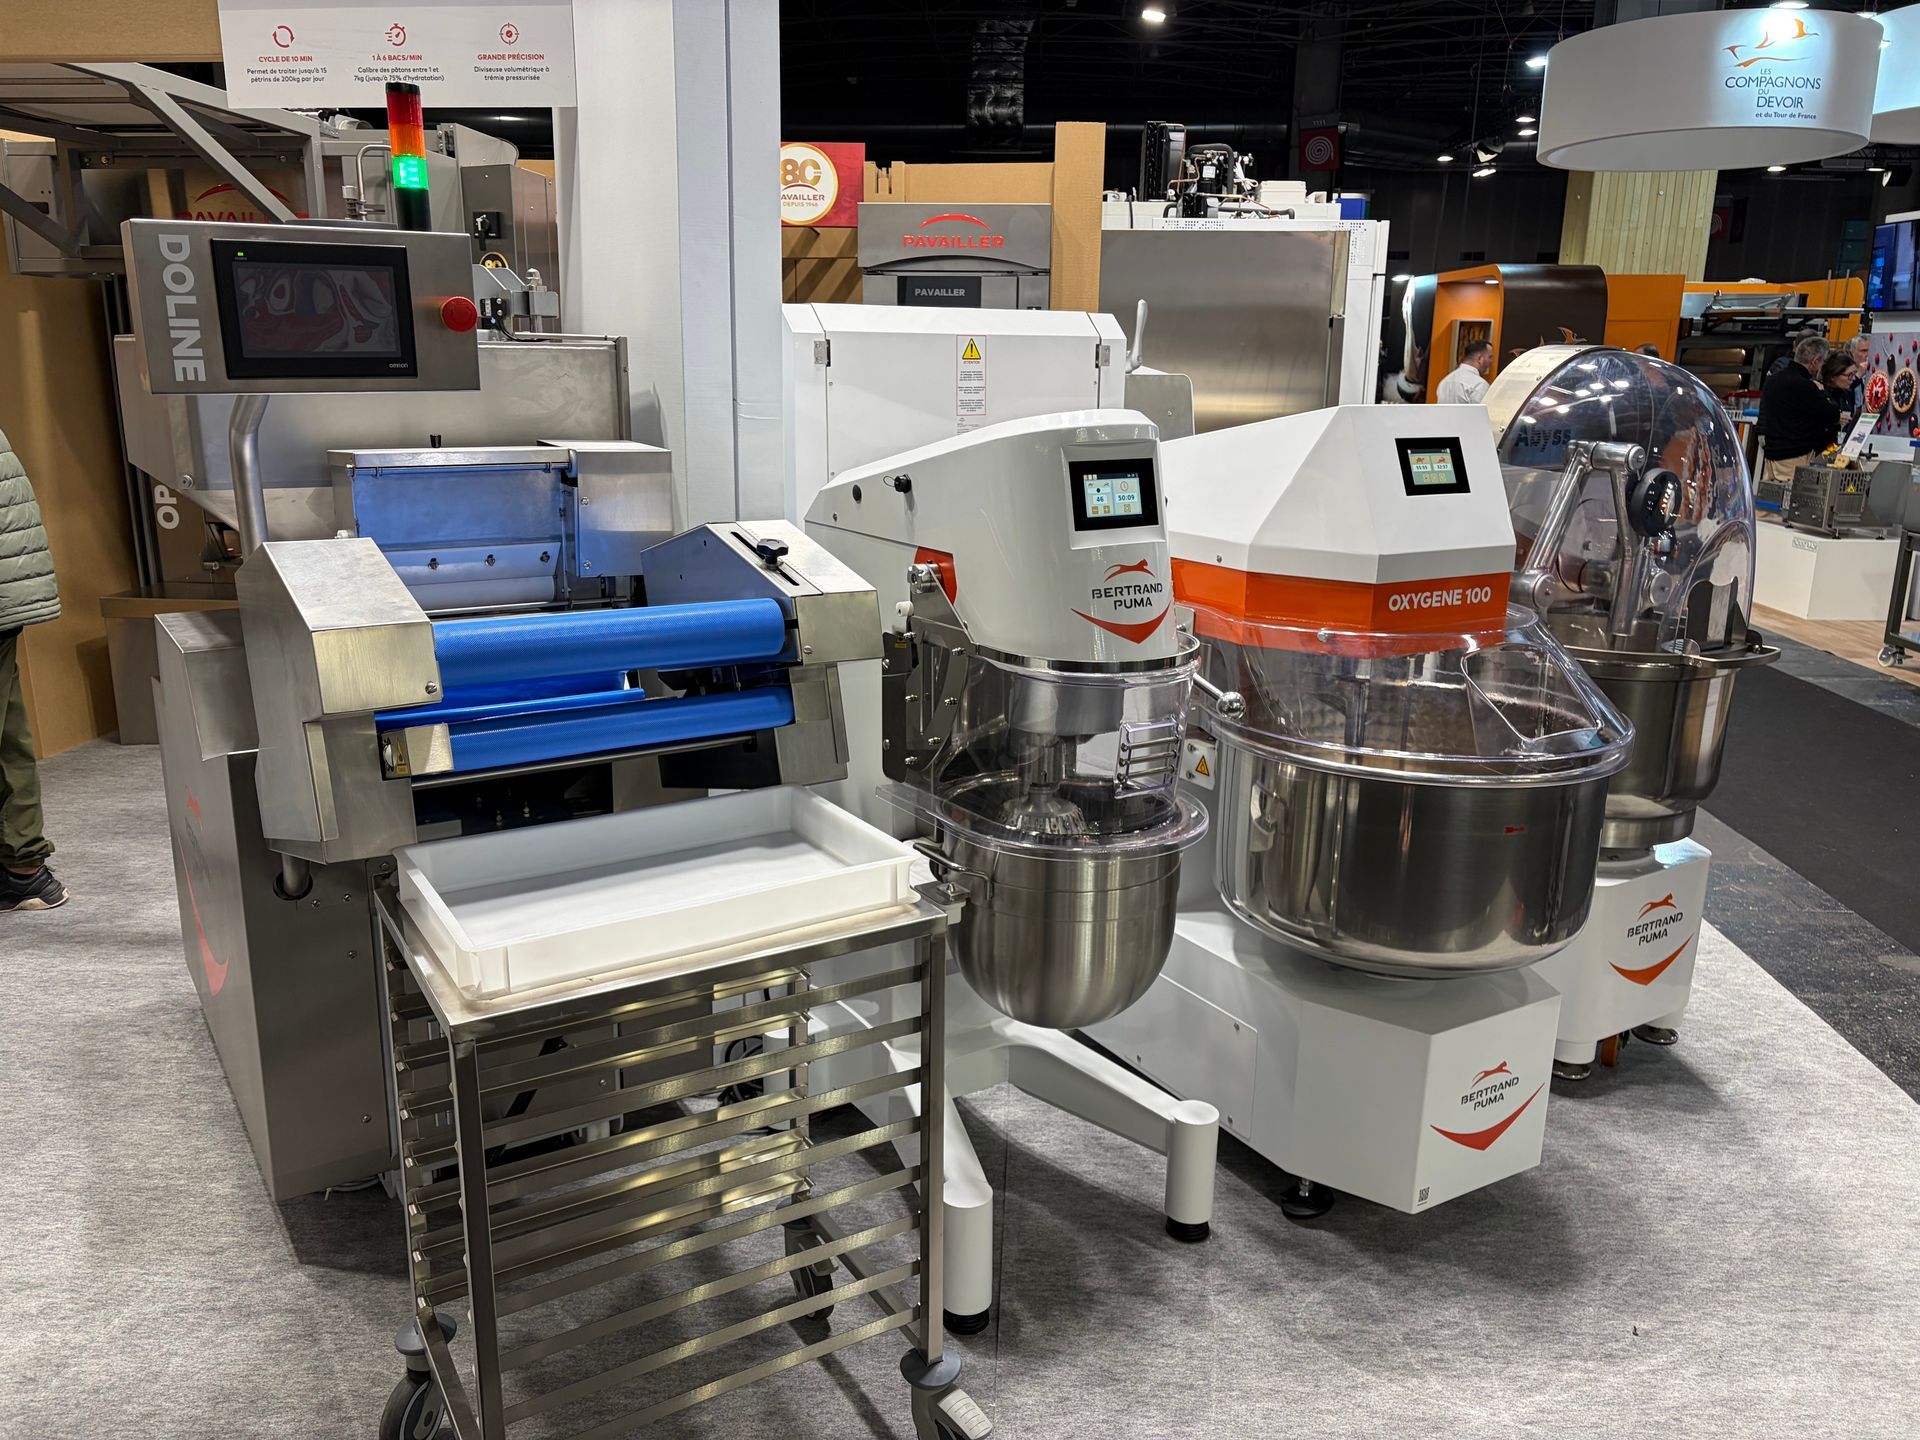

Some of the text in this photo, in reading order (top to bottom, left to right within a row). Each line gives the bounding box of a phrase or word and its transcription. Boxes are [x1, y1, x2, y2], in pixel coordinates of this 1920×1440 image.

[1725, 76, 1822, 89] COMPAGNONS
[1756, 96, 1804, 109] DEVOIR
[903, 235, 1004, 249] PAVAILLER
[915, 288, 965, 296] PAVAILLER
[158, 234, 206, 382] DOLINE
[1091, 583, 1163, 599] BERTRAND
[1388, 586, 1491, 611] OXYGENE 100
[1113, 597, 1153, 610] PUMA
[1627, 912, 1683, 938] BERTRAND
[1638, 928, 1668, 946] PUMA
[1461, 1076, 1519, 1105] BERTRAND
[1474, 1092, 1504, 1111] PUMA
